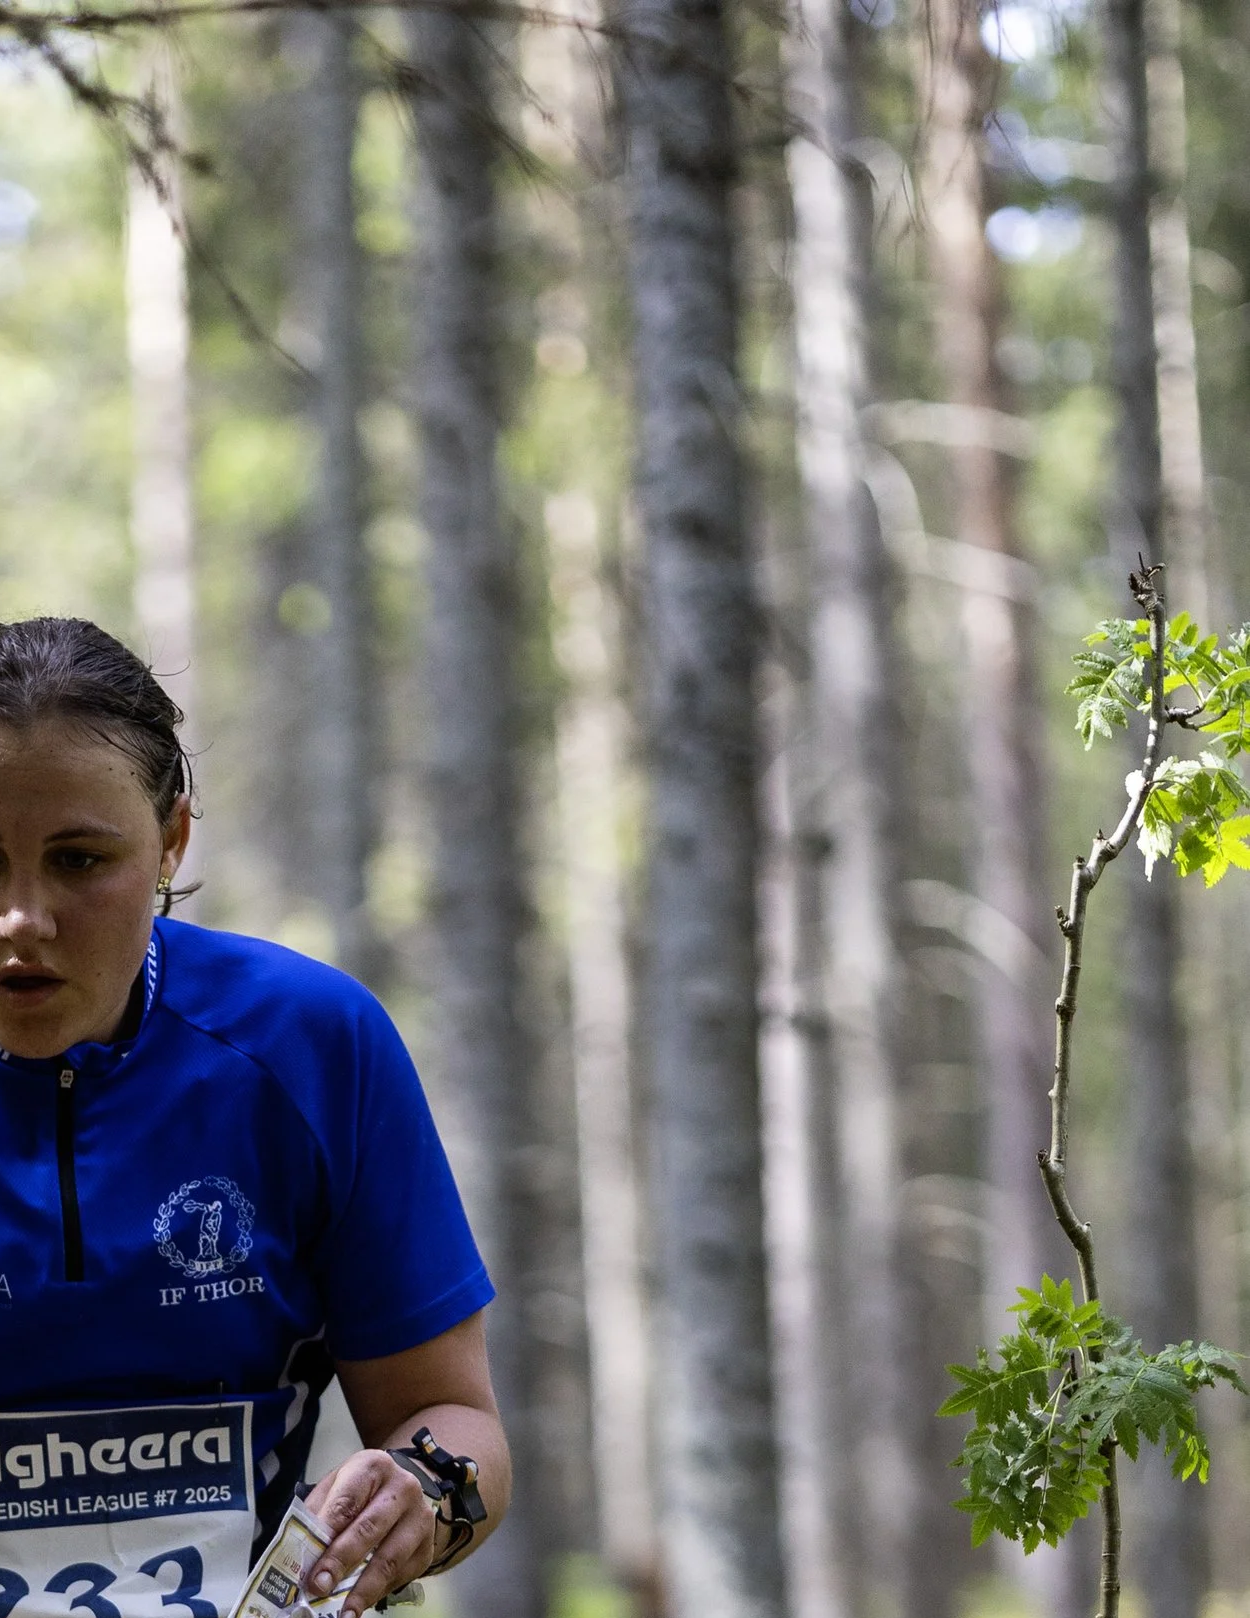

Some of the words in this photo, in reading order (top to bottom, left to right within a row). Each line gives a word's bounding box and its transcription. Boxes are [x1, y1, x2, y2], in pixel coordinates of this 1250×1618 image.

[159, 1287, 186, 1306] IF
[194, 1276, 266, 1302] THOR
[65, 1491, 150, 1515] LEAGUE
[154, 1489, 178, 1507] #7
[184, 1485, 232, 1505] 2025
[261, 1580, 286, 1603] Swedish
[269, 1572, 290, 1594] League
